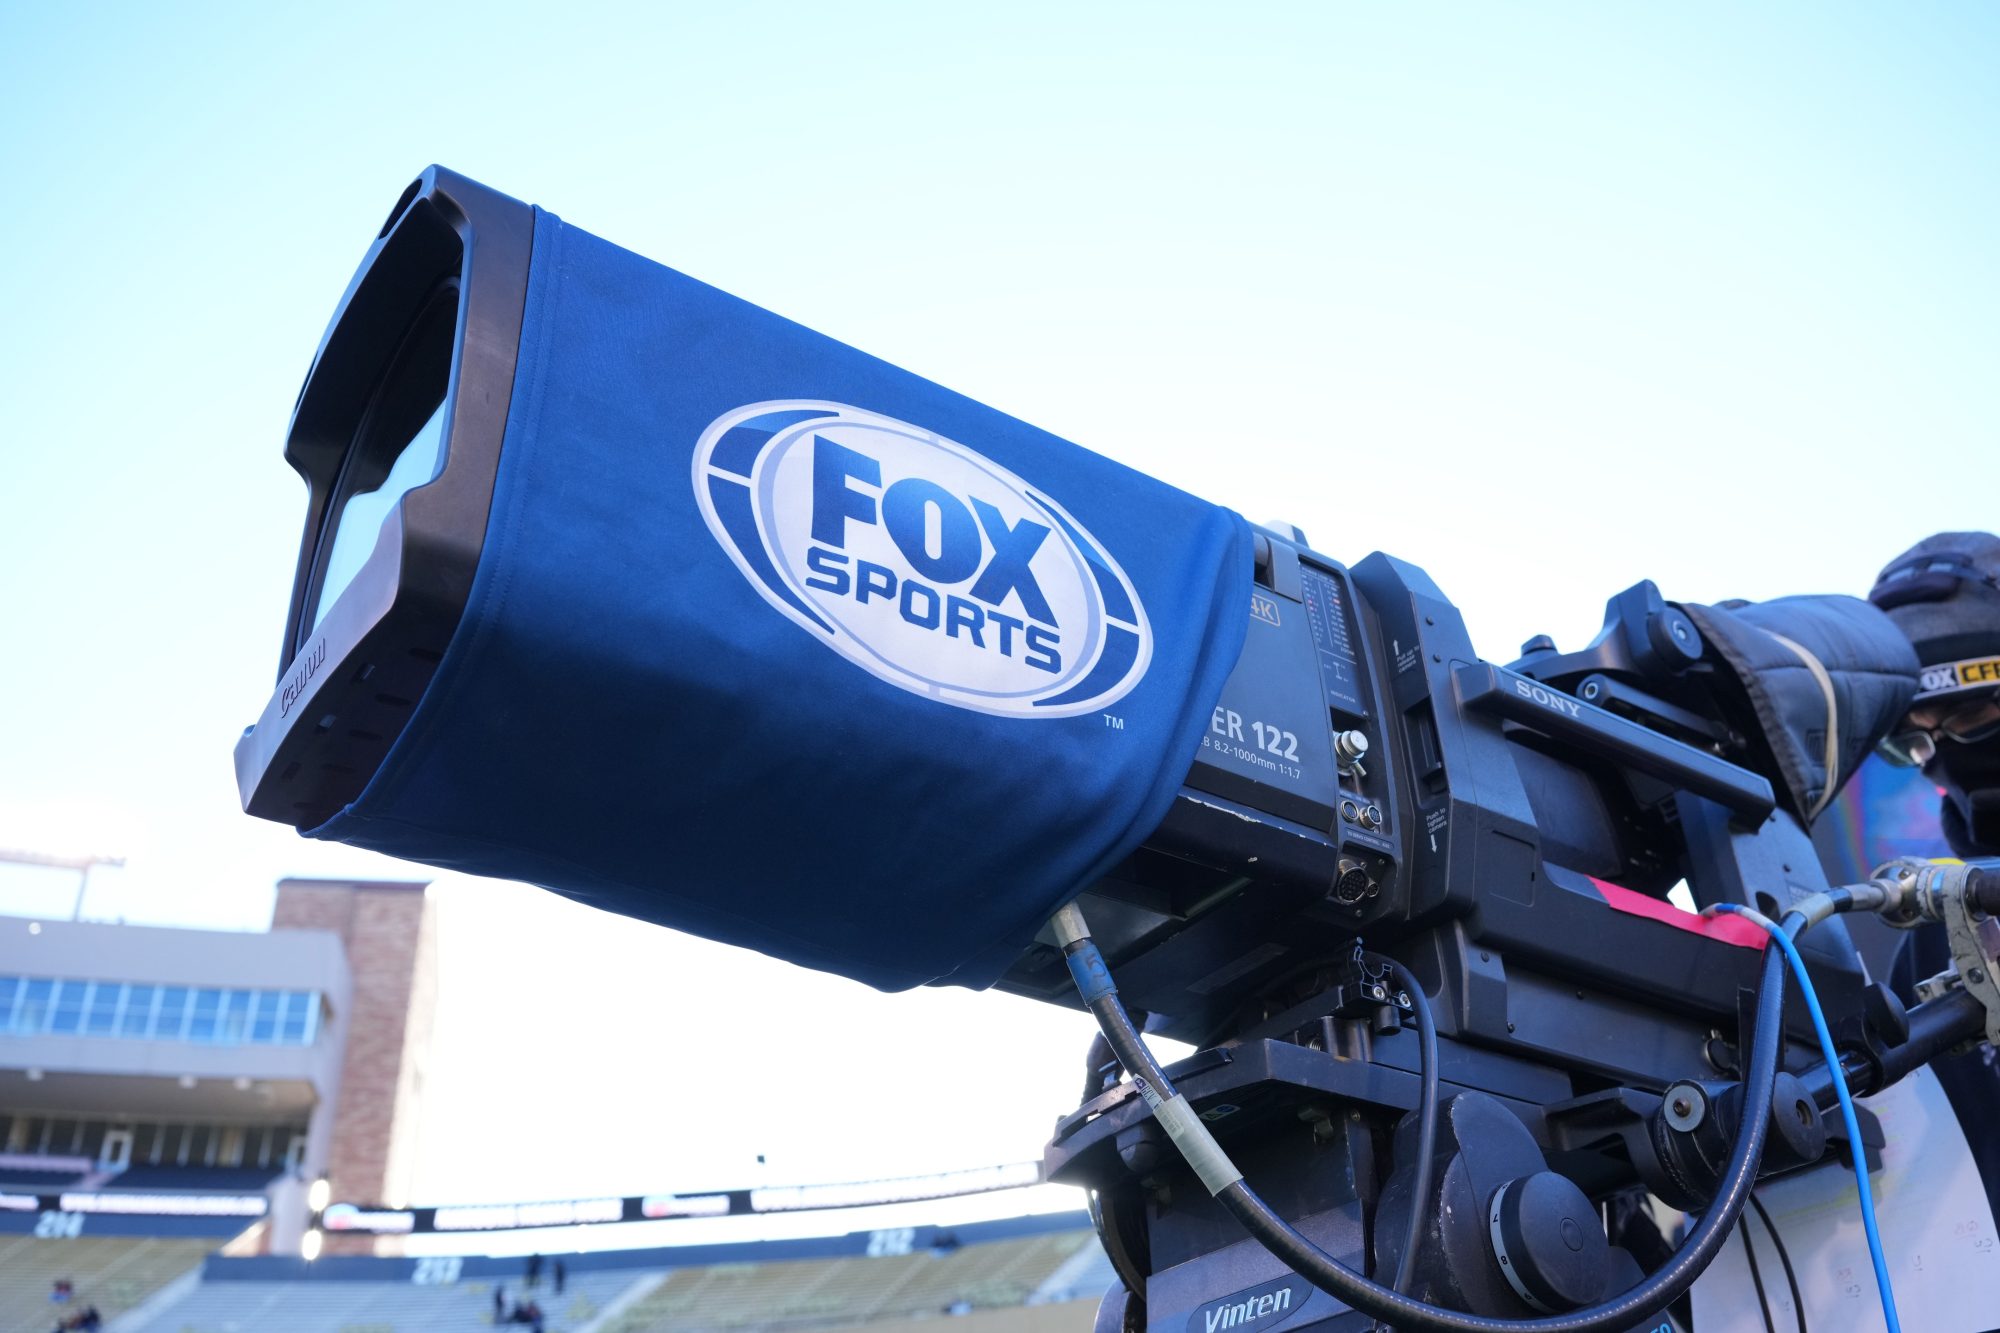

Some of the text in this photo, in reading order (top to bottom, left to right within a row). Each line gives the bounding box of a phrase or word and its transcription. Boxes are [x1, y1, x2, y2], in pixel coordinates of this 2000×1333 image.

[811, 434, 1060, 629] FOX
[806, 546, 1062, 675] SPORTS
[1251, 597, 1275, 620] 4K
[1921, 668, 1956, 690] OX
[1516, 680, 1581, 718] SONY
[1103, 713, 1124, 730] TM
[1212, 706, 1299, 763] ER 122
[1214, 740, 1276, 771] 8.2-1000mm
[1279, 764, 1301, 779] 1:1.7
[1500, 1255, 1508, 1265] 8
[1205, 1287, 1292, 1333] Vinten
